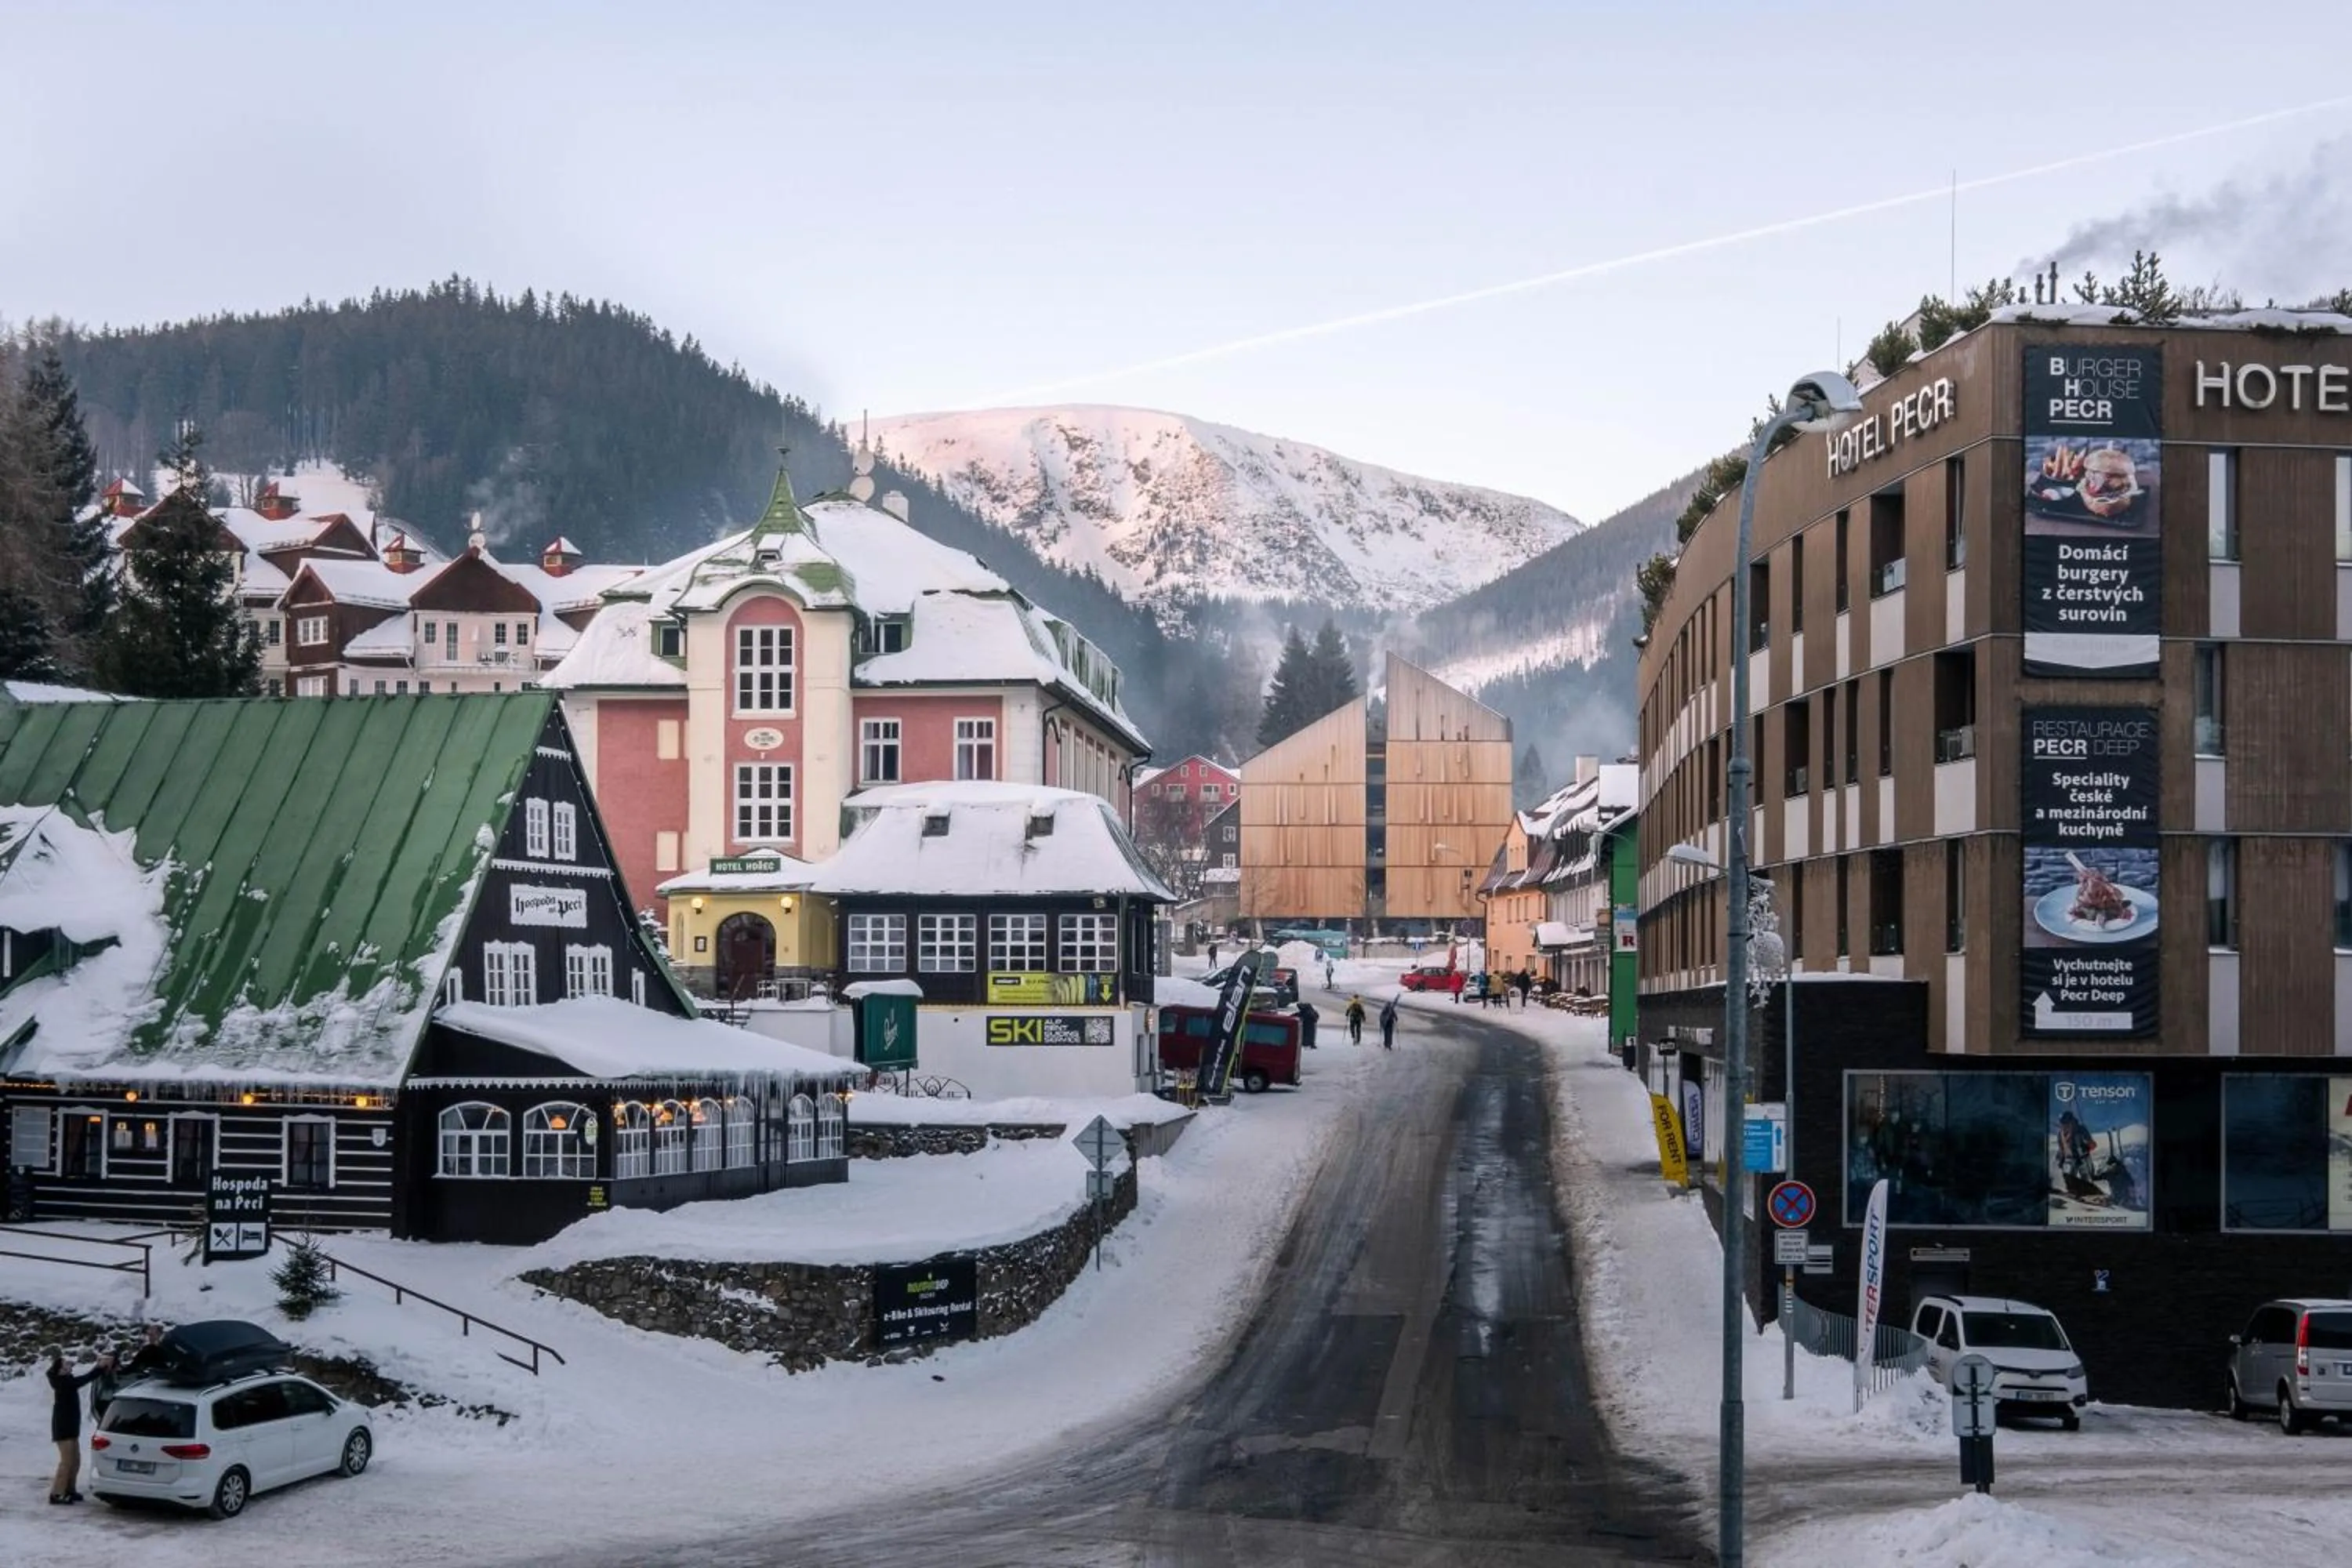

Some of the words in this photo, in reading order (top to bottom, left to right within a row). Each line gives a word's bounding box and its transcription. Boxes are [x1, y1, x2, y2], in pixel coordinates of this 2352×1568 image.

[2049, 357, 2142, 378] BURGER
[2063, 378, 2140, 400] HOUSE
[2196, 361, 2350, 412] HOTE
[2049, 398, 2114, 419] PECR
[1826, 414, 1886, 479] HOTEL
[1891, 377, 1951, 445] PECR
[2058, 543, 2129, 561] Domácí
[2057, 564, 2129, 585] burgery
[2042, 588, 2053, 601] z
[2056, 583, 2144, 606] čerstvých
[2058, 605, 2128, 622] surovin
[2032, 720, 2150, 738] RESTAURACE
[2033, 739, 2088, 755] PECR
[2092, 739, 2140, 756] DEEP
[2052, 771, 2130, 790] Speciality
[2069, 788, 2114, 803] české
[2035, 808, 2045, 819] a
[2049, 805, 2148, 820] mezinárodní
[2058, 822, 2125, 840] kuchyně
[715, 862, 742, 871] HOTEL
[2053, 957, 2133, 973] Vychutnejte
[2052, 973, 2063, 986] si
[2064, 973, 2078, 989] je
[2079, 976, 2089, 986] v
[2090, 973, 2134, 986] hotelu
[2090, 989, 2126, 1004] Deep
[990, 1018, 1044, 1043] SKI
[1657, 1103, 1673, 1131] FOR
[1664, 1132, 1682, 1165] RENT
[212, 1175, 268, 1194] Hospoda
[215, 1199, 231, 1210] na
[235, 1195, 264, 1210] Peci
